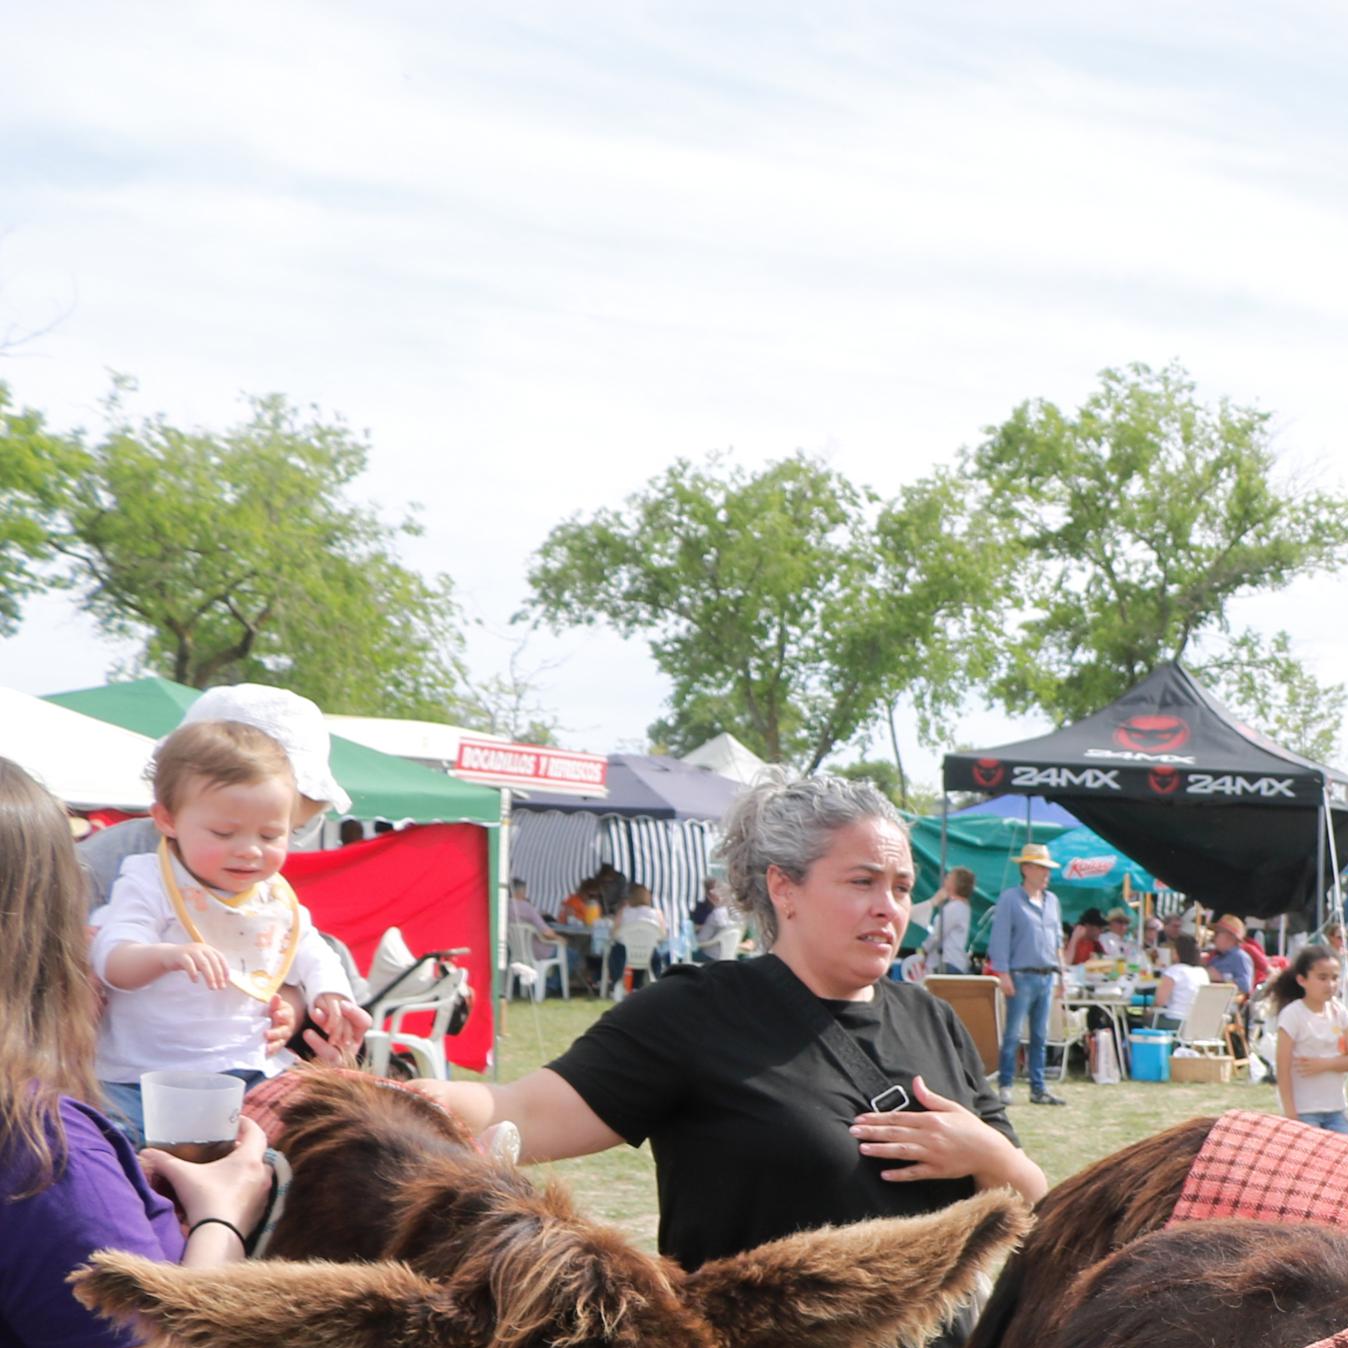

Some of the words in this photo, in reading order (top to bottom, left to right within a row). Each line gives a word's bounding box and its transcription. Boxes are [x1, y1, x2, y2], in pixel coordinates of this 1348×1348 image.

[461, 746, 536, 776] BOCADILLOS
[538, 756, 548, 776] Y
[547, 757, 603, 783] REFRESCOS
[1084, 749, 1195, 764] 24MX
[1011, 766, 1122, 790] 24MX
[1187, 774, 1296, 798] 24MX
